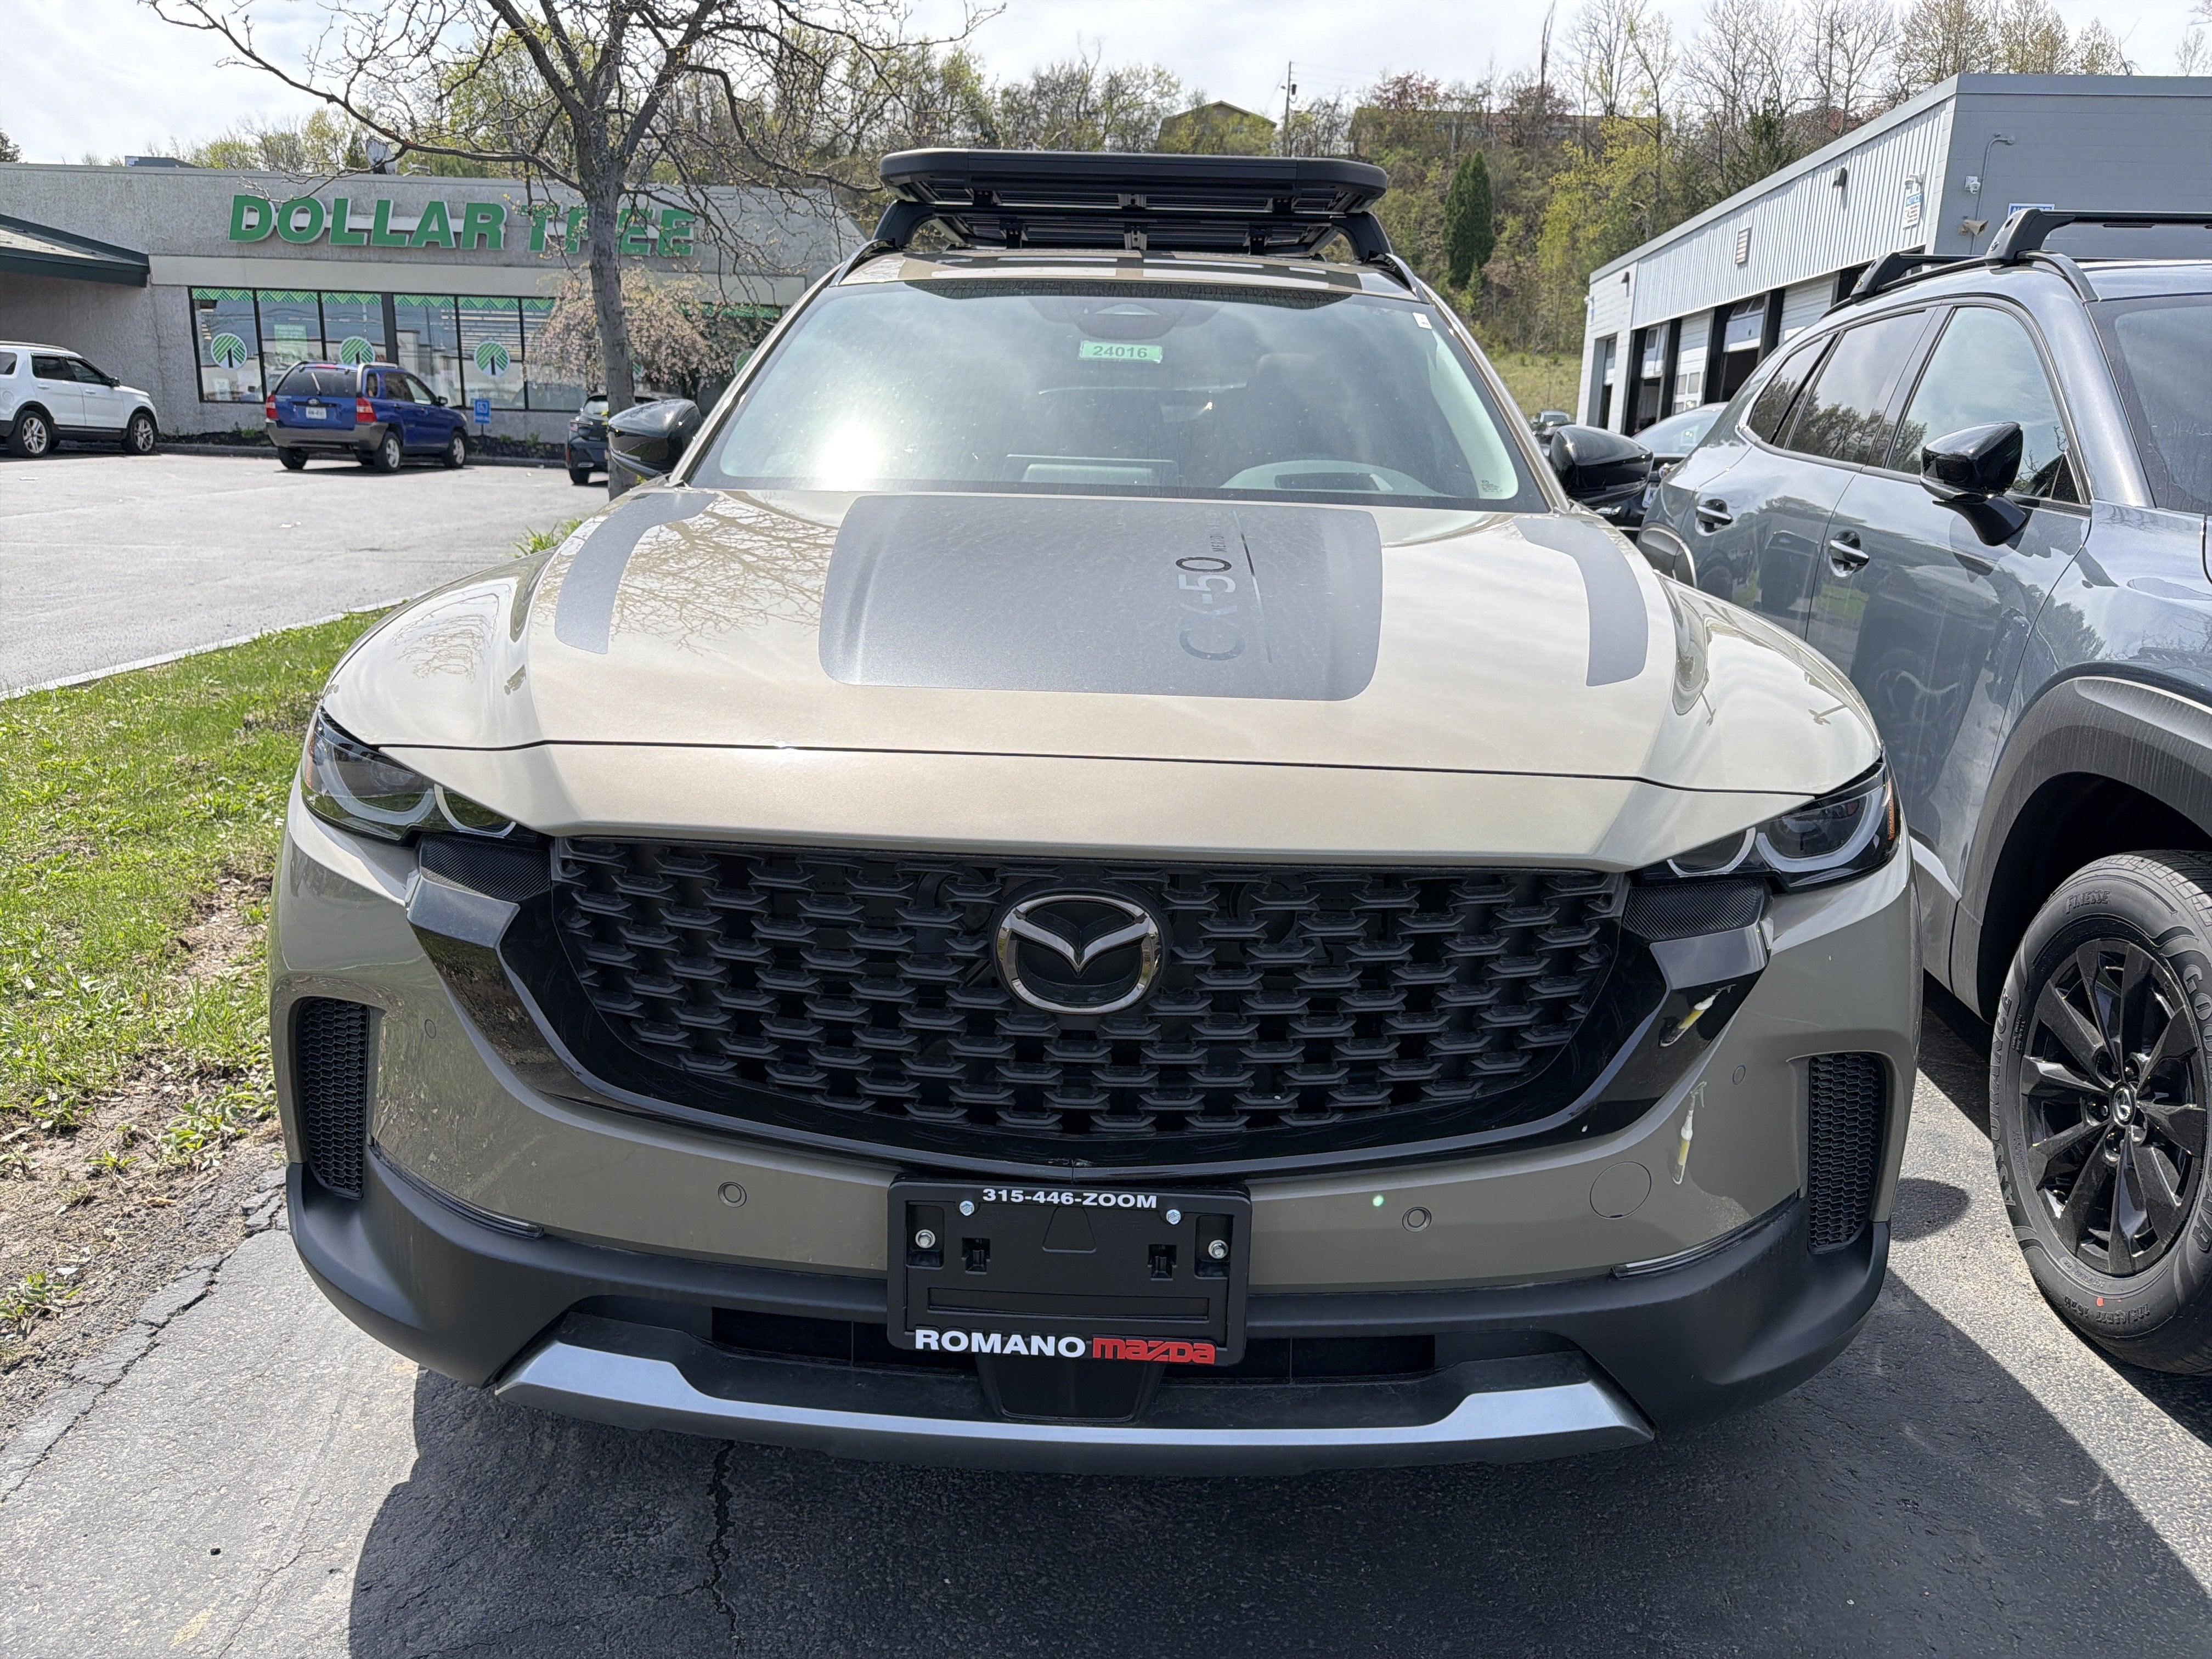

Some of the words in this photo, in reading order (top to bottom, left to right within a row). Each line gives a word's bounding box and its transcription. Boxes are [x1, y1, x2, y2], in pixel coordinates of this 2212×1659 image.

[228, 194, 506, 250] DOLLAR
[1092, 346, 1147, 358] 24016
[1176, 556, 1245, 661] CX-50
[2065, 889, 2111, 915] FINESSE
[1989, 988, 2016, 1206] ASSURANCE
[983, 1188, 1156, 1209] 315-446-ZOOM
[915, 1329, 1086, 1358] ROMANO
